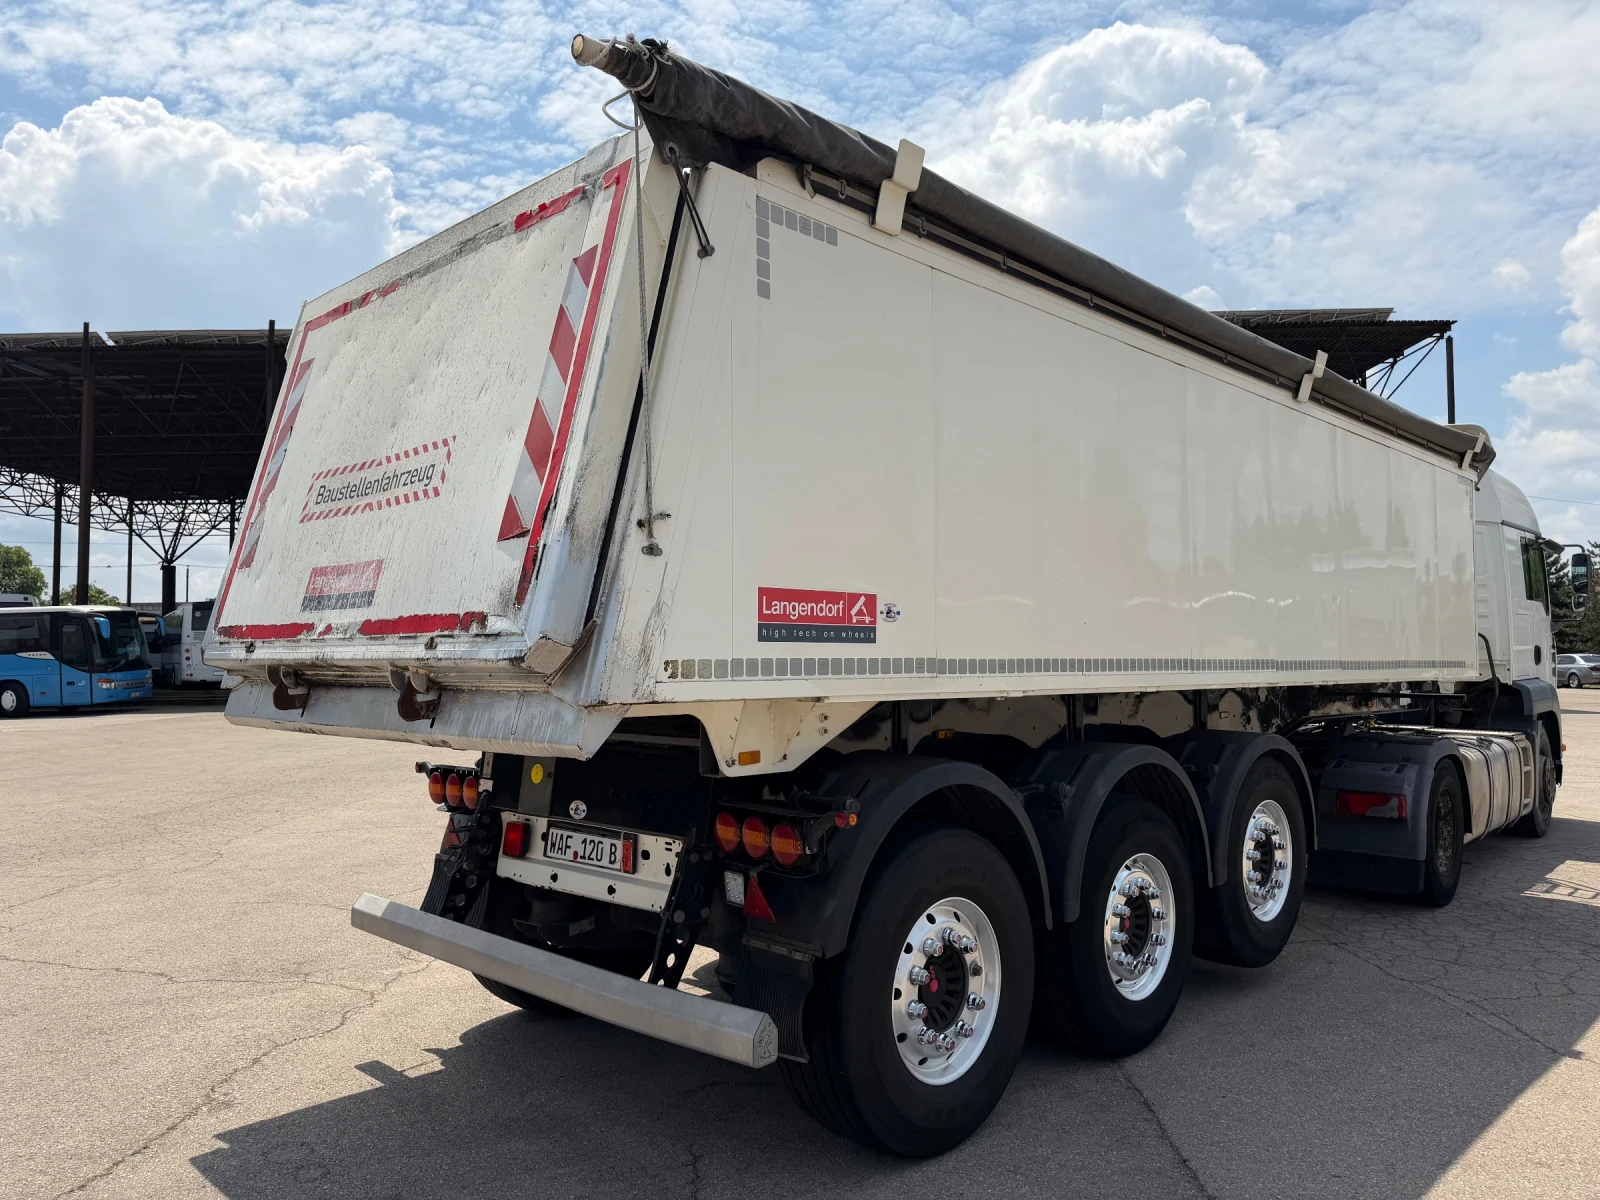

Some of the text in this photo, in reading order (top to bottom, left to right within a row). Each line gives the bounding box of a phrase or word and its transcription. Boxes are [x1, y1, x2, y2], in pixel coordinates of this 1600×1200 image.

[315, 463, 436, 506] Baustellenfahrzeug
[762, 595, 844, 620] Langendorf
[762, 628, 787, 639] high
[793, 629, 817, 638] tech
[841, 630, 875, 639] wheels
[549, 831, 574, 857] WAF
[579, 838, 604, 863] 120
[608, 842, 618, 865] B
